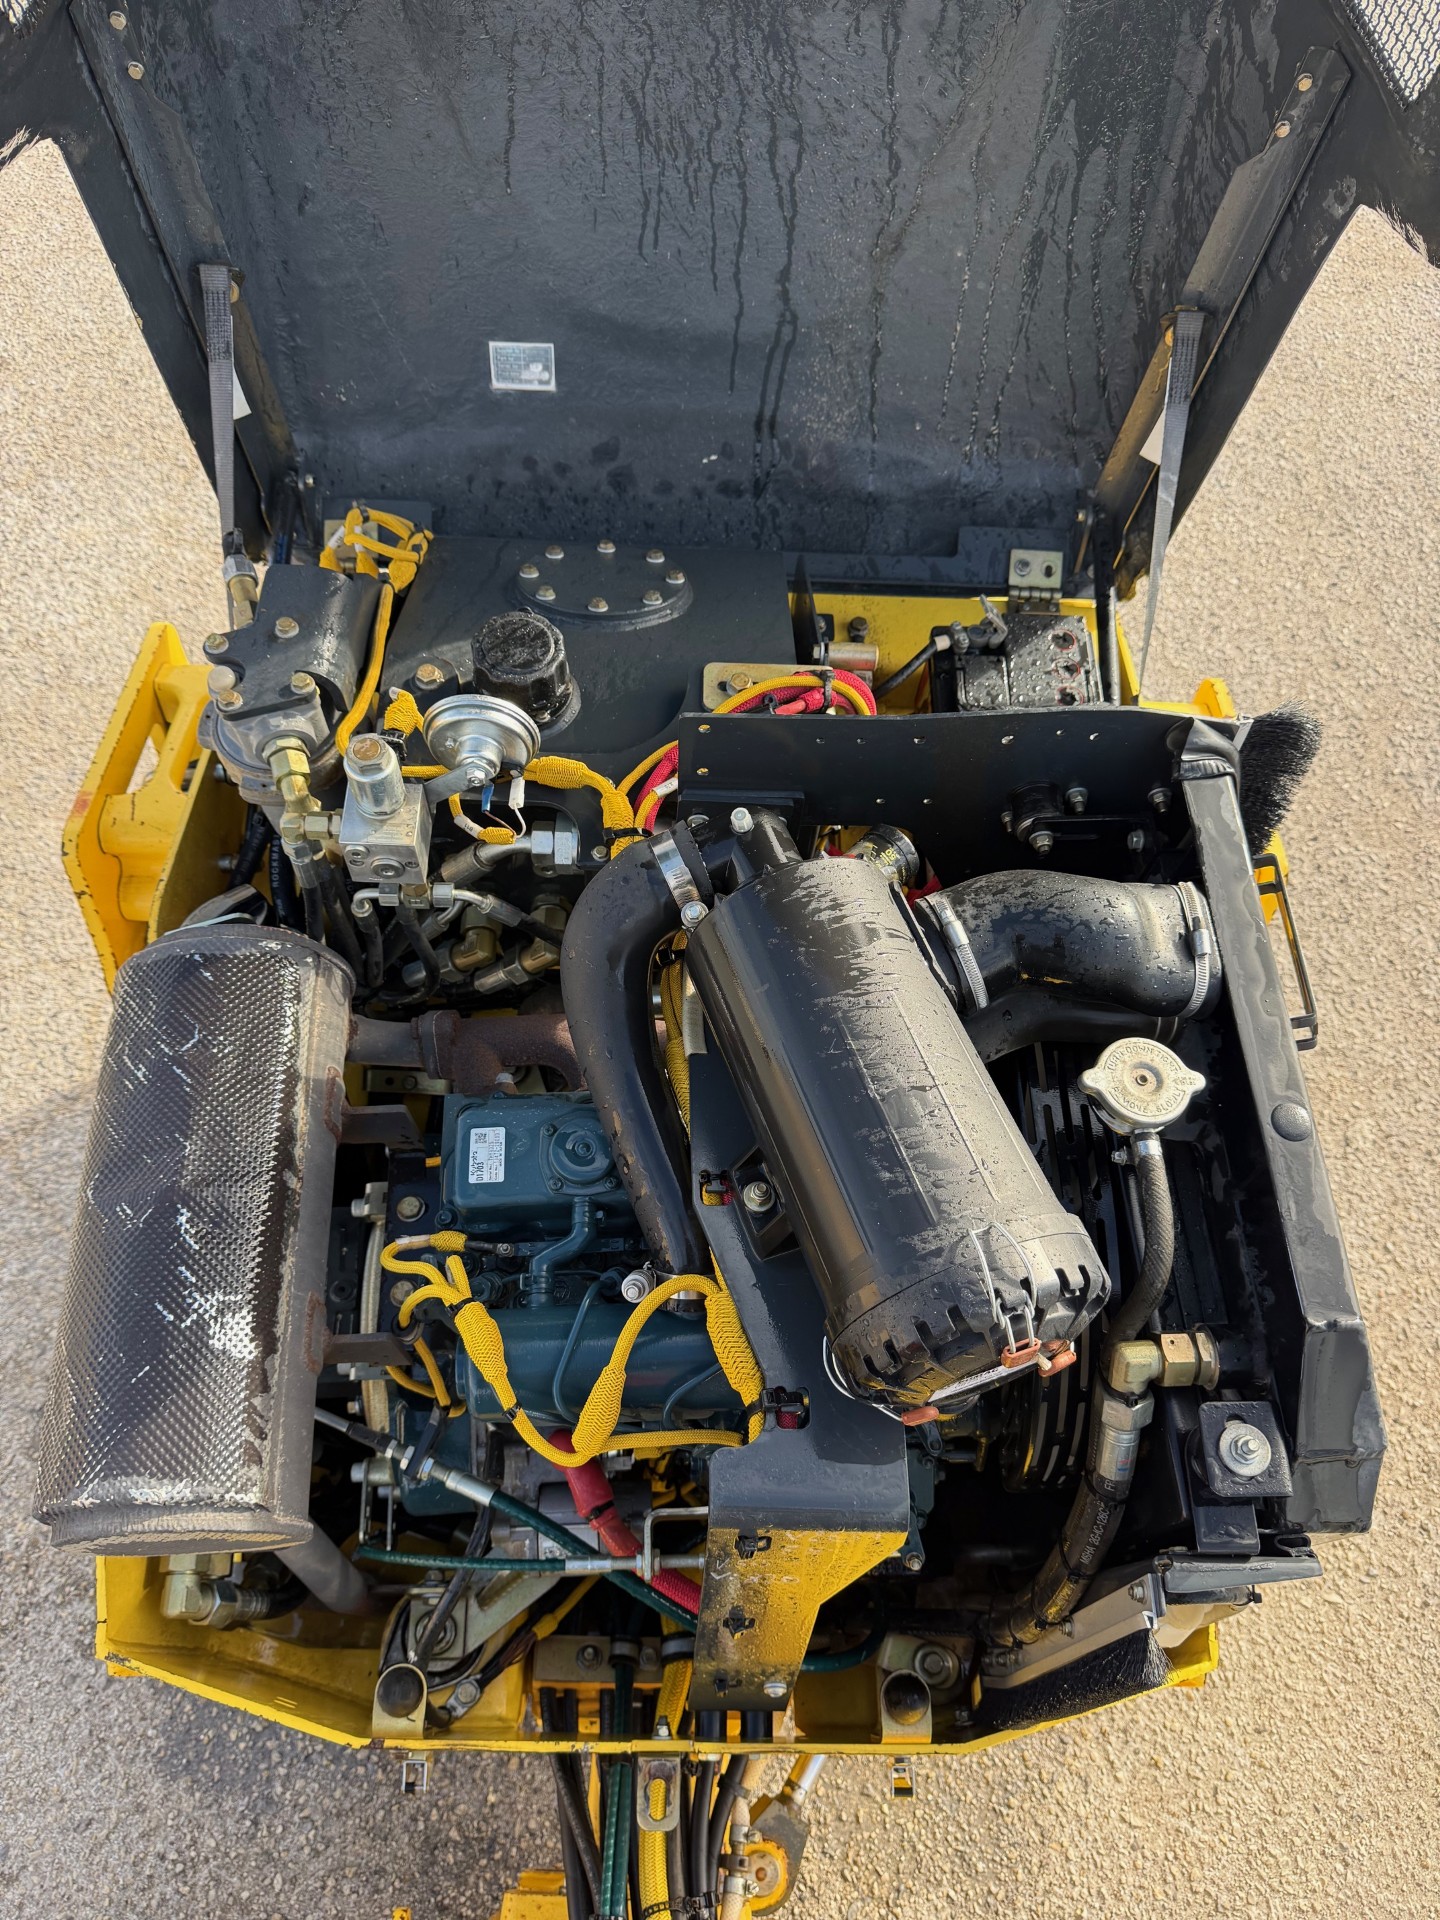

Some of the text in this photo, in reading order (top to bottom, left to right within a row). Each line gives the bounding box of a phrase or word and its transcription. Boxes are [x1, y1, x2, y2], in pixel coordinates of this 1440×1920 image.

[1125, 1044, 1154, 1054] DOWN
[476, 1162, 485, 1182] D1703
[1079, 1545, 1097, 1565] MSHA
